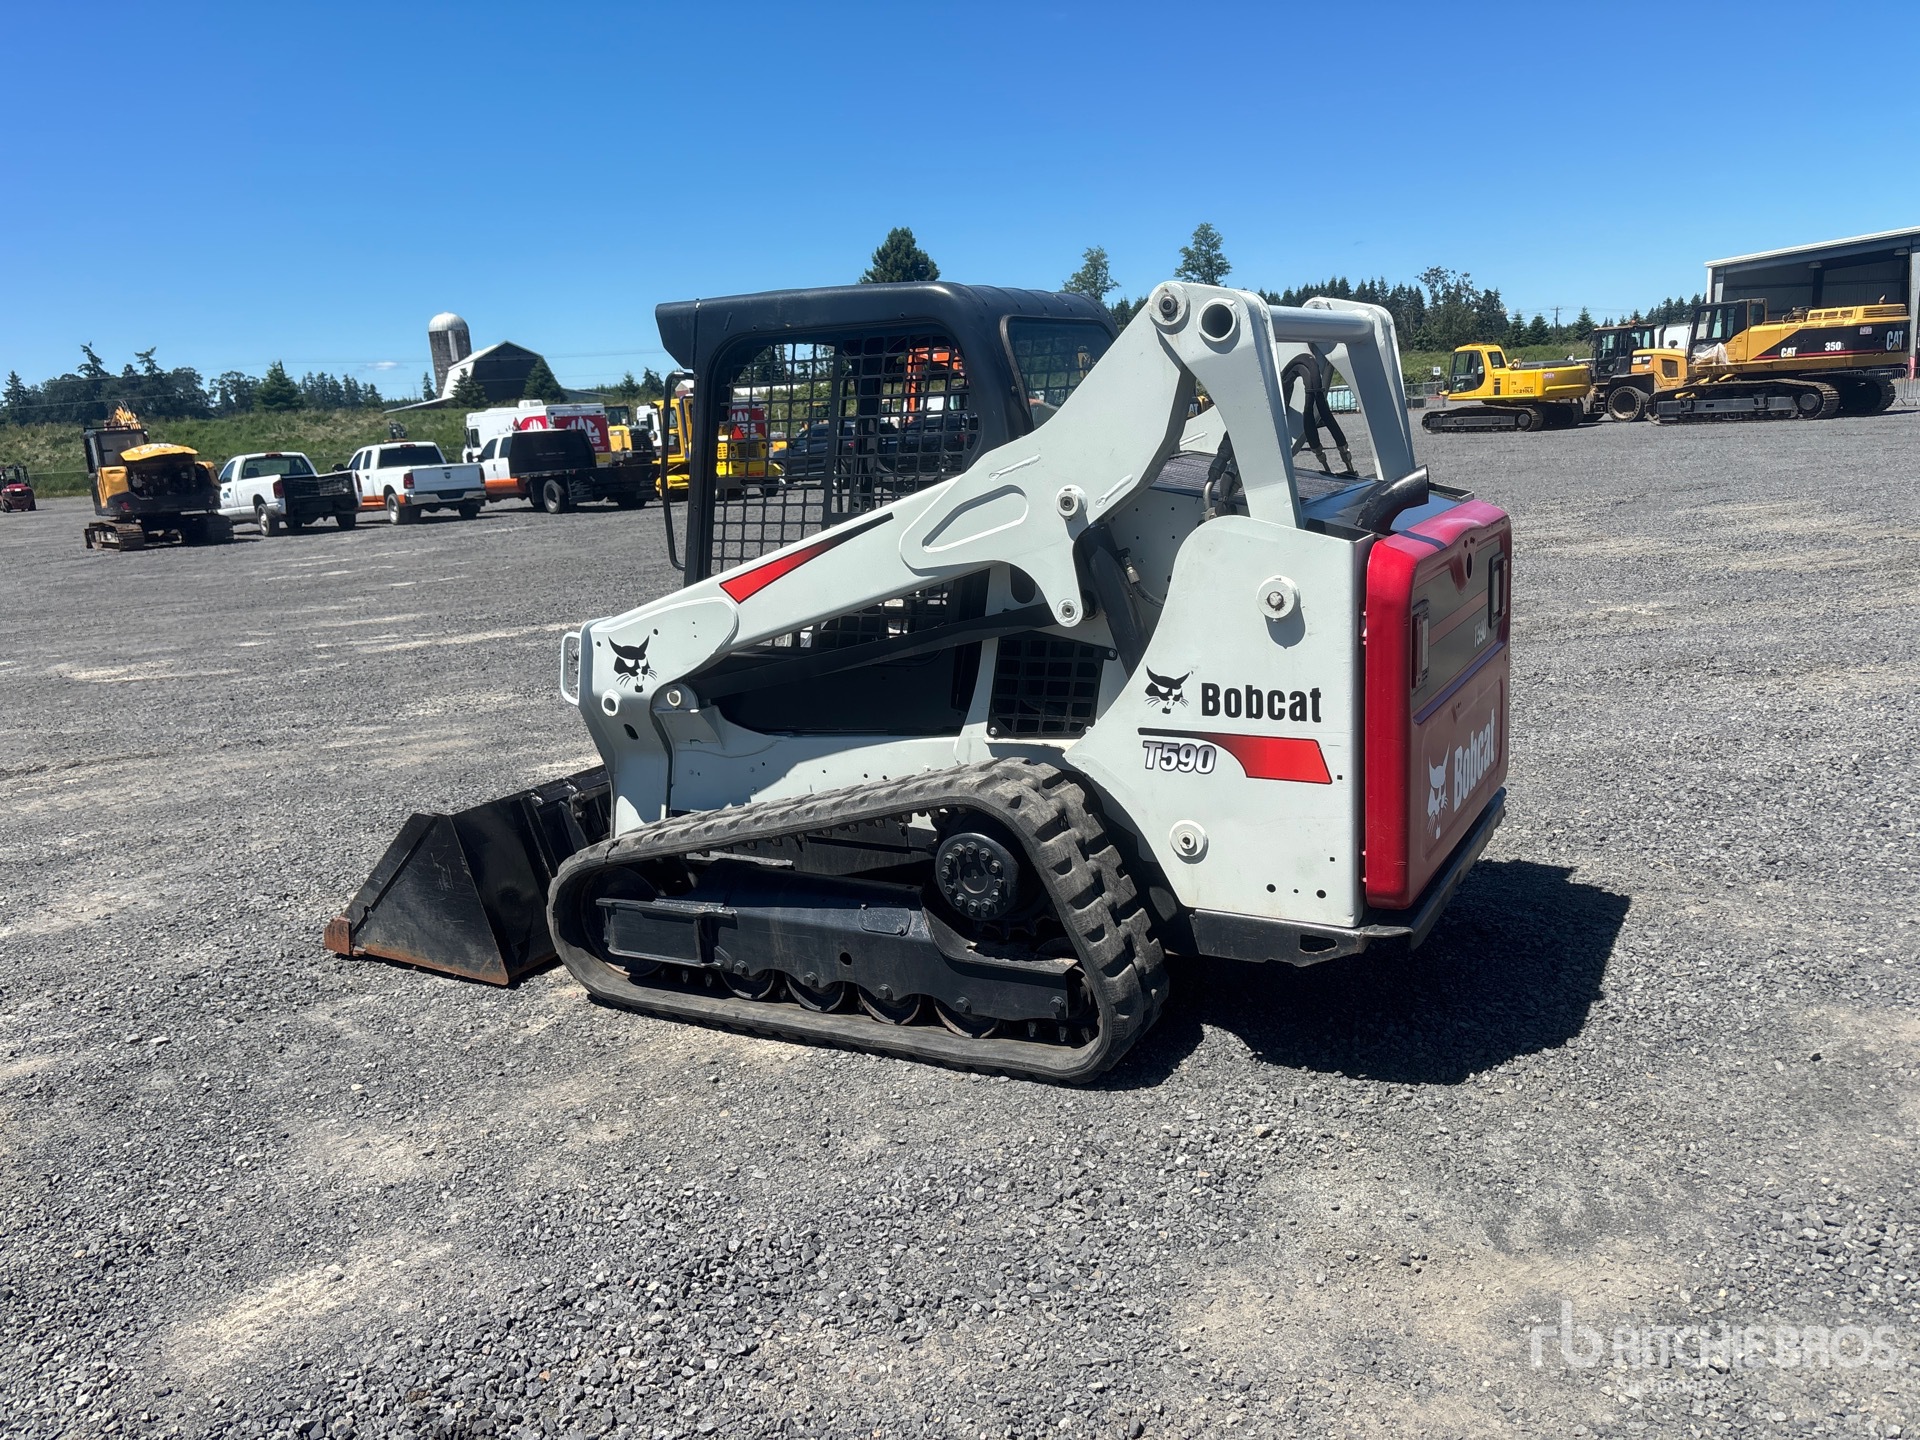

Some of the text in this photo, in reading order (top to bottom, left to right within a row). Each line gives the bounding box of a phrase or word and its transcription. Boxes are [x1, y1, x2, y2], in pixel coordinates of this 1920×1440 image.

[1780, 346, 1798, 358] CAT
[1886, 330, 1904, 351] CAT
[1201, 682, 1322, 723] Bobcat
[1142, 740, 1217, 774] T590
[1453, 707, 1496, 813] Bobcat
